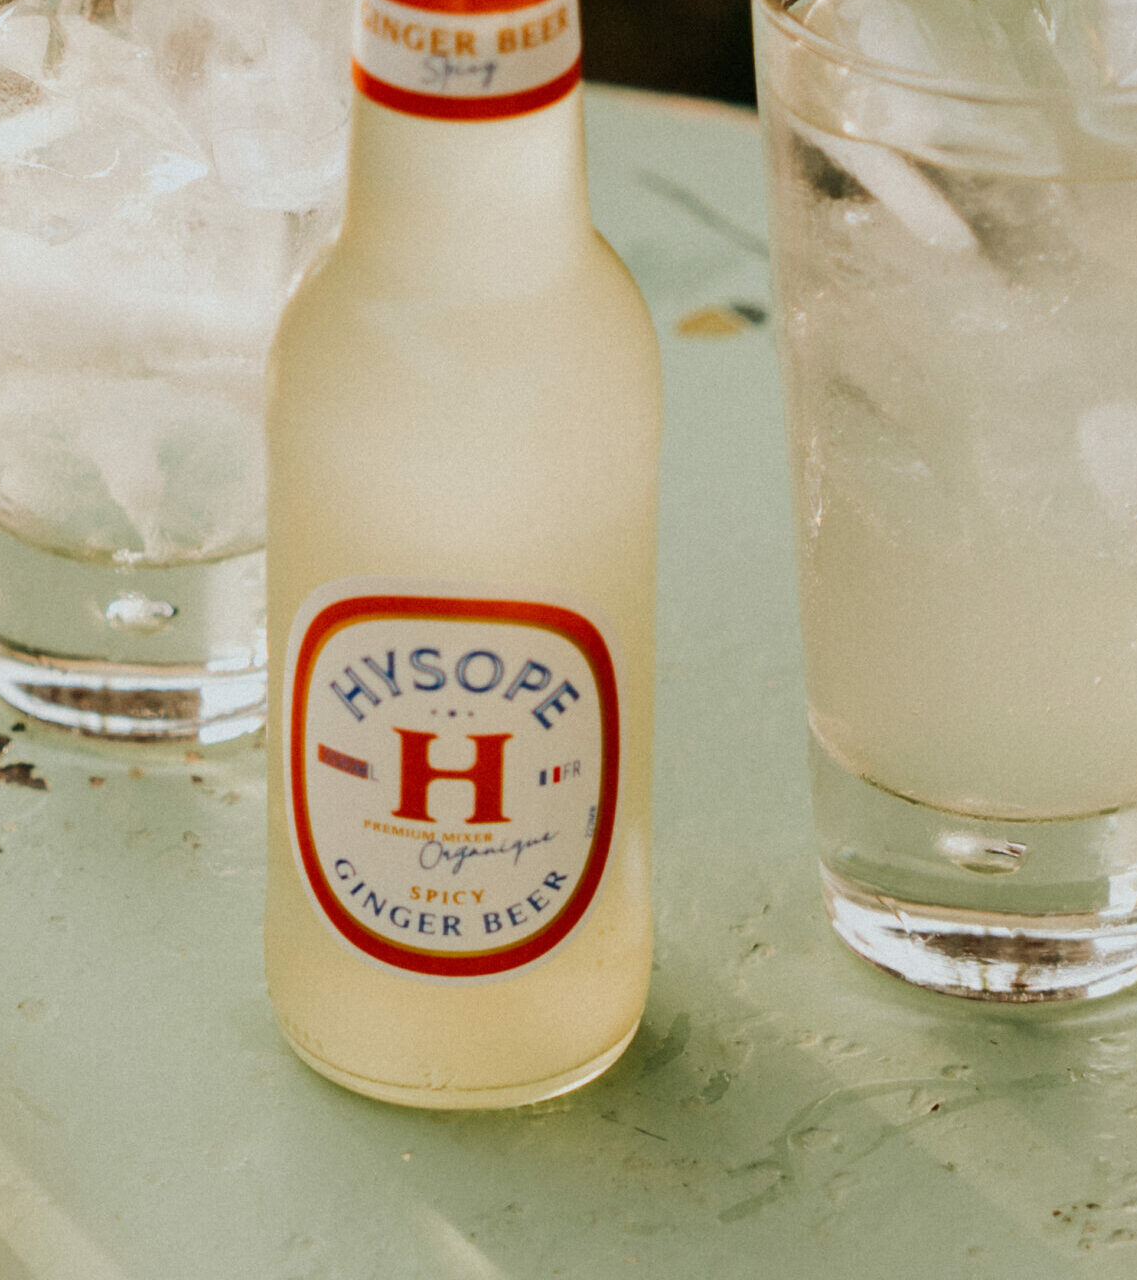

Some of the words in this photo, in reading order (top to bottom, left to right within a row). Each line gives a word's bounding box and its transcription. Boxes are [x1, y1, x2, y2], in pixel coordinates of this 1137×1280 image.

[495, 7, 570, 55] BEER
[329, 646, 581, 732] HYSOPE
[389, 725, 515, 825] H
[362, 818, 436, 843] PREMIUM
[441, 830, 494, 844] MIXER
[418, 829, 560, 875] Organique
[333, 857, 463, 938] GINGER
[483, 867, 569, 937] BEER
[409, 885, 486, 906] SPICY
